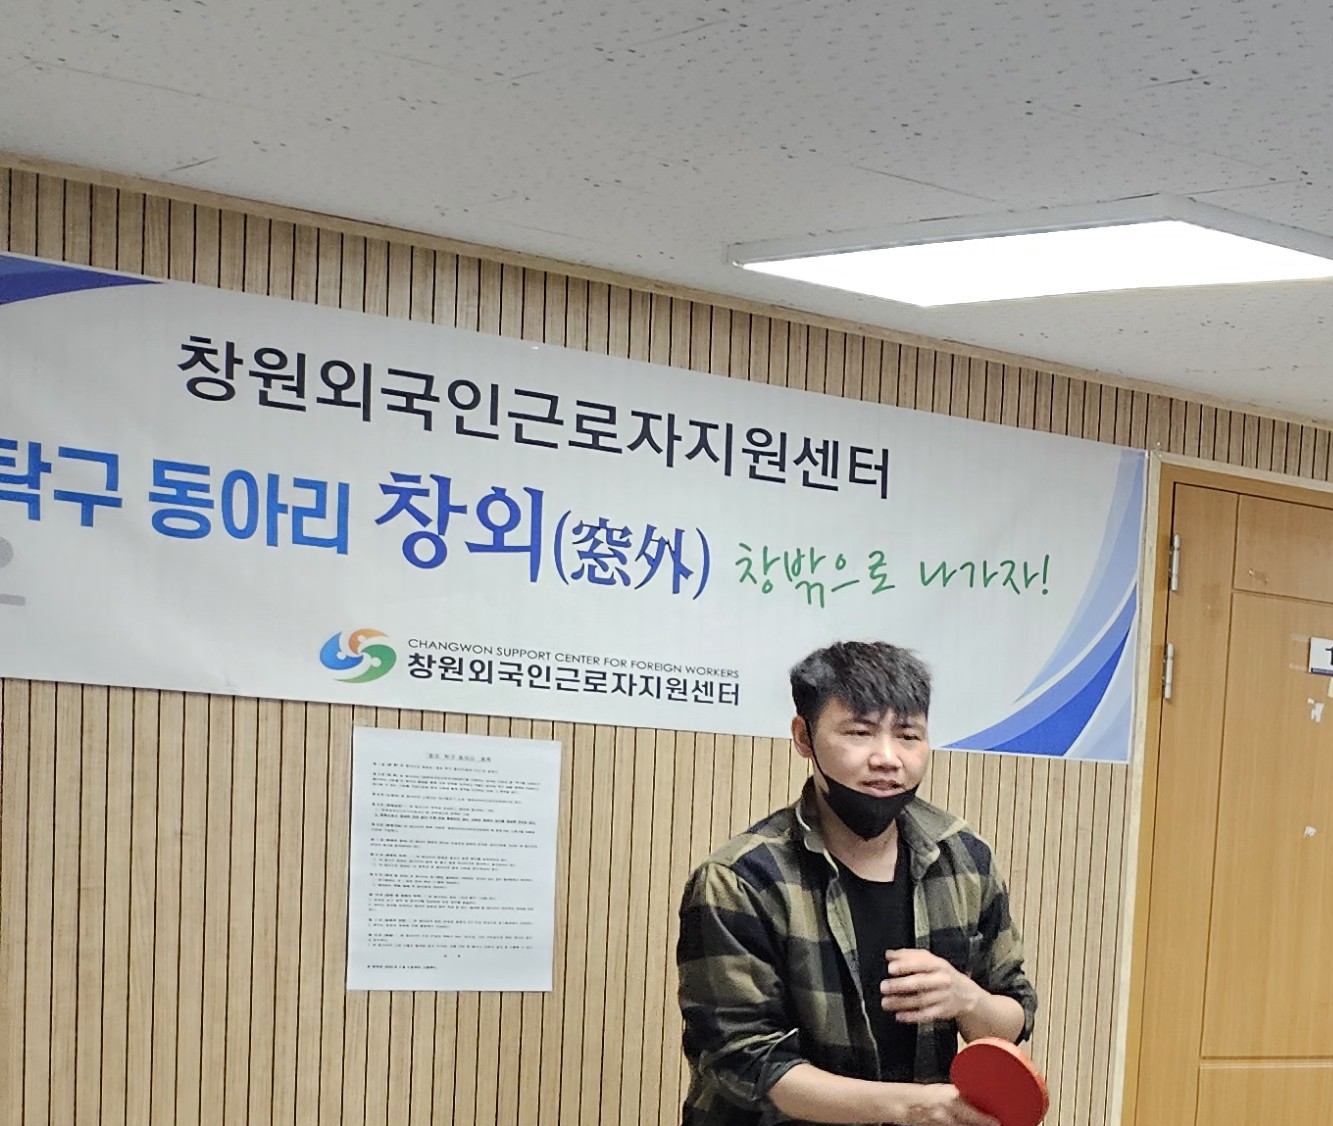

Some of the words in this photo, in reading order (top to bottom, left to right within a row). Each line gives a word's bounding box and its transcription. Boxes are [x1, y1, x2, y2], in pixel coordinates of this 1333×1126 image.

[176, 334, 890, 500] 창원외국인근로자지원센터
[0, 438, 123, 528] 탁구
[147, 457, 352, 556] 동아리
[734, 541, 897, 609] 창밖으로
[919, 554, 1051, 597] 나가자!
[407, 652, 740, 707] 창원외국인근로자지원센터
[408, 638, 493, 656] CHANGWON
[496, 647, 552, 662] SUPPORT
[554, 652, 601, 666] CENTER
[603, 657, 628, 668] FOR
[631, 660, 682, 674] FOREIGN
[685, 665, 740, 679] WORKERS
